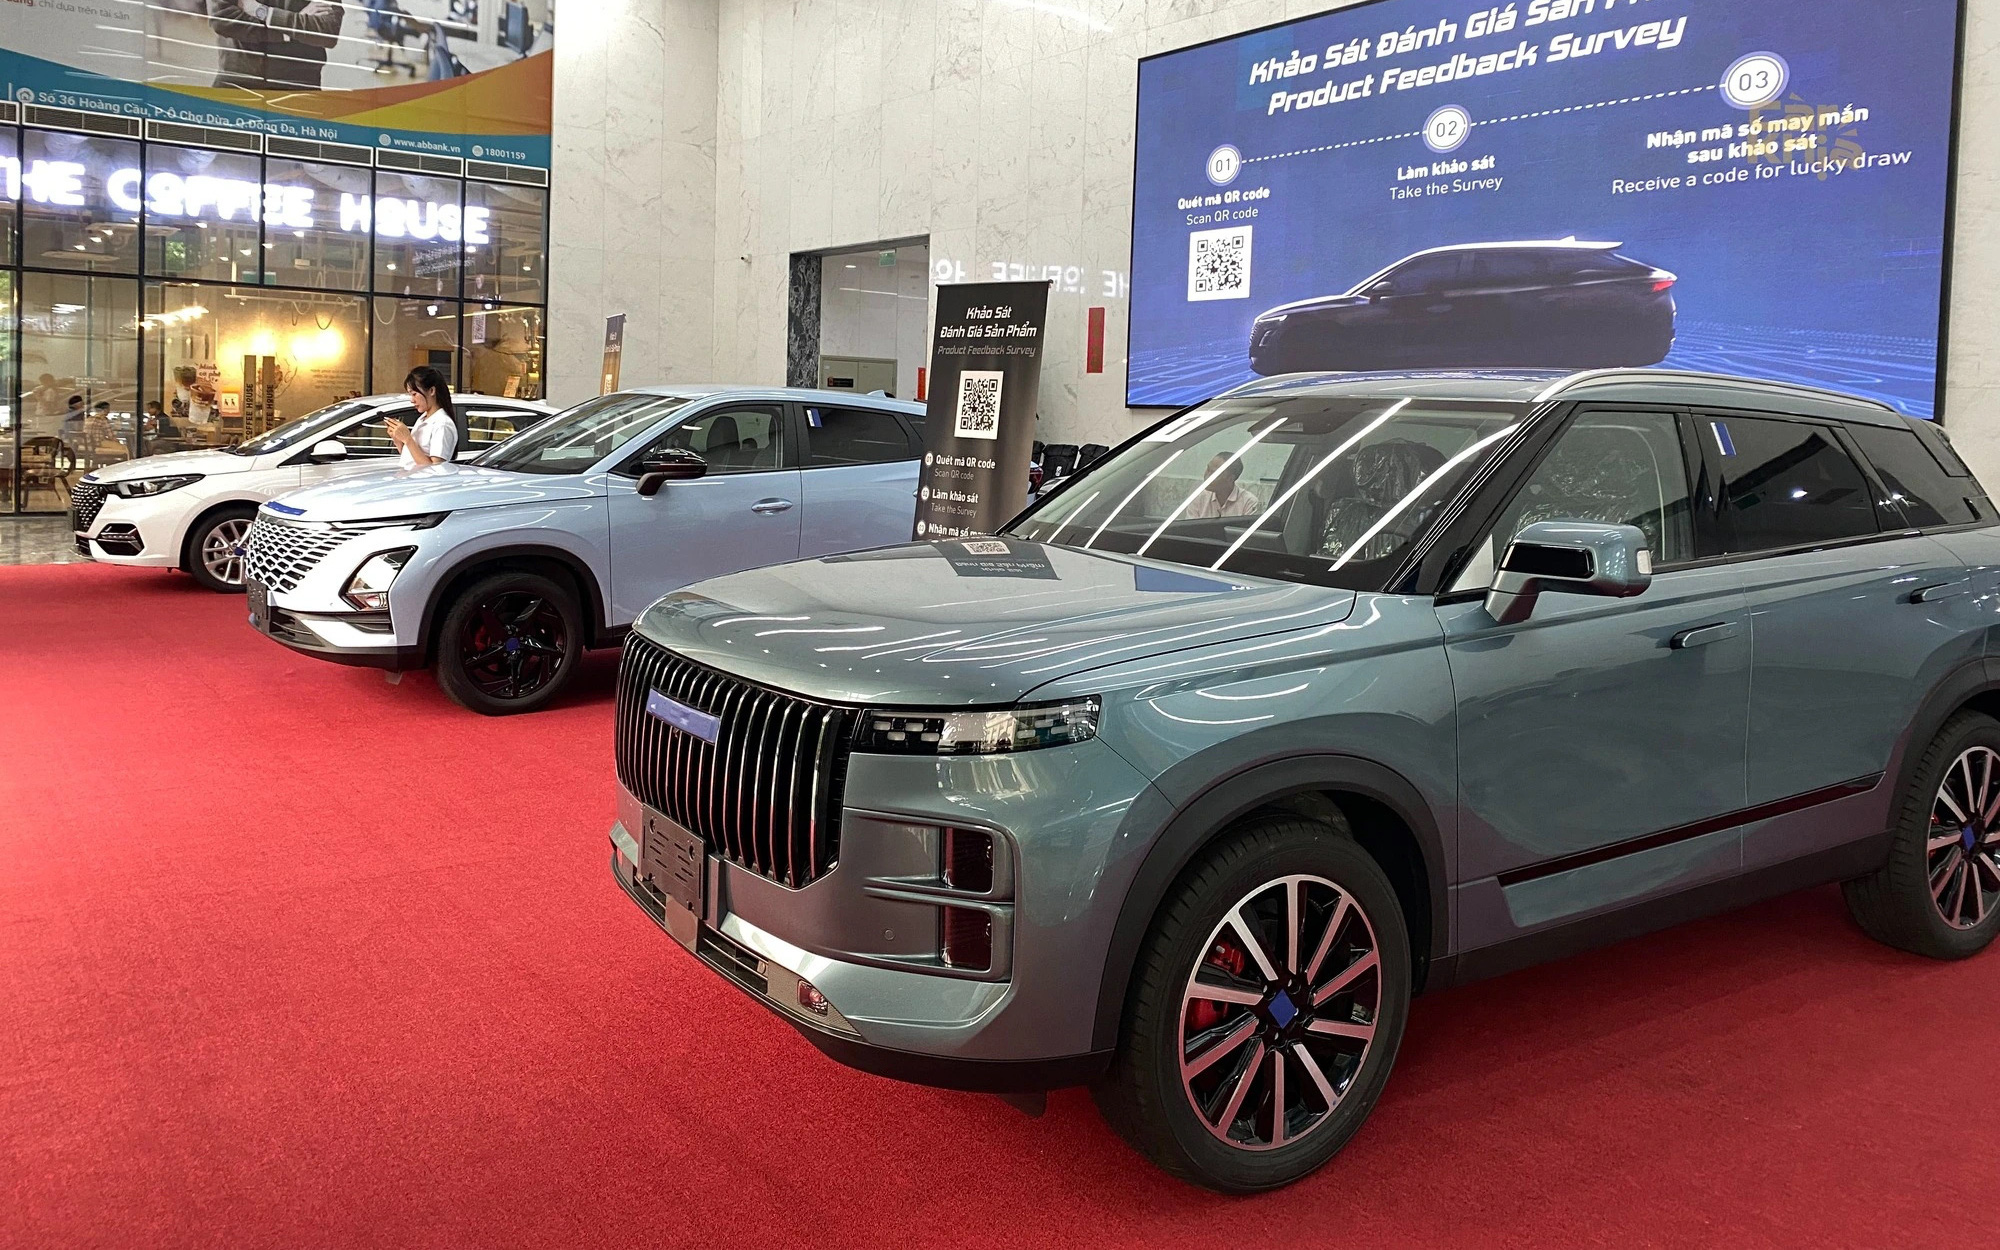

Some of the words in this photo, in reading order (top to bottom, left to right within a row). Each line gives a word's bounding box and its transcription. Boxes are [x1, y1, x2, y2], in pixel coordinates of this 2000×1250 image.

[99, 9, 112, 18] tài
[1249, 50, 1318, 86] Khảo
[1323, 38, 1371, 70] Sát
[1376, 18, 1458, 58] Đánh
[1464, 3, 1518, 39] Giá
[1267, 74, 1375, 116] Product
[1379, 40, 1539, 94] Feedback
[1546, 16, 1688, 63] Survey
[1739, 70, 1769, 92] 03
[38, 91, 56, 103] Số
[59, 94, 76, 106] 36
[79, 97, 121, 114] Hoàng
[123, 101, 151, 117] Cầu,
[280, 124, 298, 136] Đa,
[301, 125, 317, 137] Hà
[319, 128, 338, 140] Nội
[1436, 120, 1457, 138] 02
[1647, 127, 1697, 149] Nhận
[1701, 123, 1733, 142] mã
[1737, 116, 1762, 137] số
[1767, 113, 1815, 133] may
[1819, 103, 1869, 127] mắn
[393, 138, 461, 153] www.abbank.vn
[485, 148, 526, 160] 18001159
[1687, 145, 1723, 164] sau
[1728, 139, 1779, 160] khảo
[1783, 132, 1818, 153] sát
[1215, 158, 1231, 173] 01
[1397, 165, 1429, 181] Làm
[1431, 158, 1468, 177] khảo
[1470, 154, 1496, 171] sát
[1612, 175, 1681, 195] Receive
[1685, 174, 1697, 187] a
[1702, 166, 1749, 185] code
[1754, 162, 1785, 180] for
[1790, 155, 1848, 176] lucky
[1853, 150, 1912, 169] draw
[1389, 185, 1422, 200] Take
[1426, 182, 1449, 196] the
[1452, 176, 1503, 192] Survey
[0, 156, 85, 206] HE
[107, 168, 314, 228] COFFEE
[339, 192, 490, 245] HOUSE
[1177, 196, 1203, 210] Quét
[1204, 193, 1222, 207] mã
[1224, 190, 1241, 204] QR
[1242, 186, 1271, 201] code
[1186, 214, 1212, 226] Scan
[1214, 209, 1230, 222] QR
[1232, 206, 1259, 220] code
[966, 305, 993, 320] Khảo
[994, 305, 1012, 319] Sát
[940, 325, 966, 338] Đánh
[967, 325, 983, 337] Giá
[984, 323, 1005, 338] Sản
[1006, 321, 1037, 338] Phẩm
[938, 345, 966, 355] Product
[967, 345, 1005, 355] Feedback
[1006, 345, 1036, 358] Survey
[246, 383, 254, 409] HOUSE
[936, 454, 953, 466] Quét
[966, 457, 976, 468] QR
[977, 459, 996, 469] code
[934, 468, 949, 478] Scan
[950, 469, 960, 479] QR
[960, 470, 974, 480] code
[932, 489, 949, 500] Làm
[949, 490, 966, 502] khảo
[967, 492, 979, 504] sát
[931, 503, 945, 512] Take
[945, 505, 956, 514] the
[957, 506, 977, 518] Survey
[928, 523, 948, 537] Nhận
